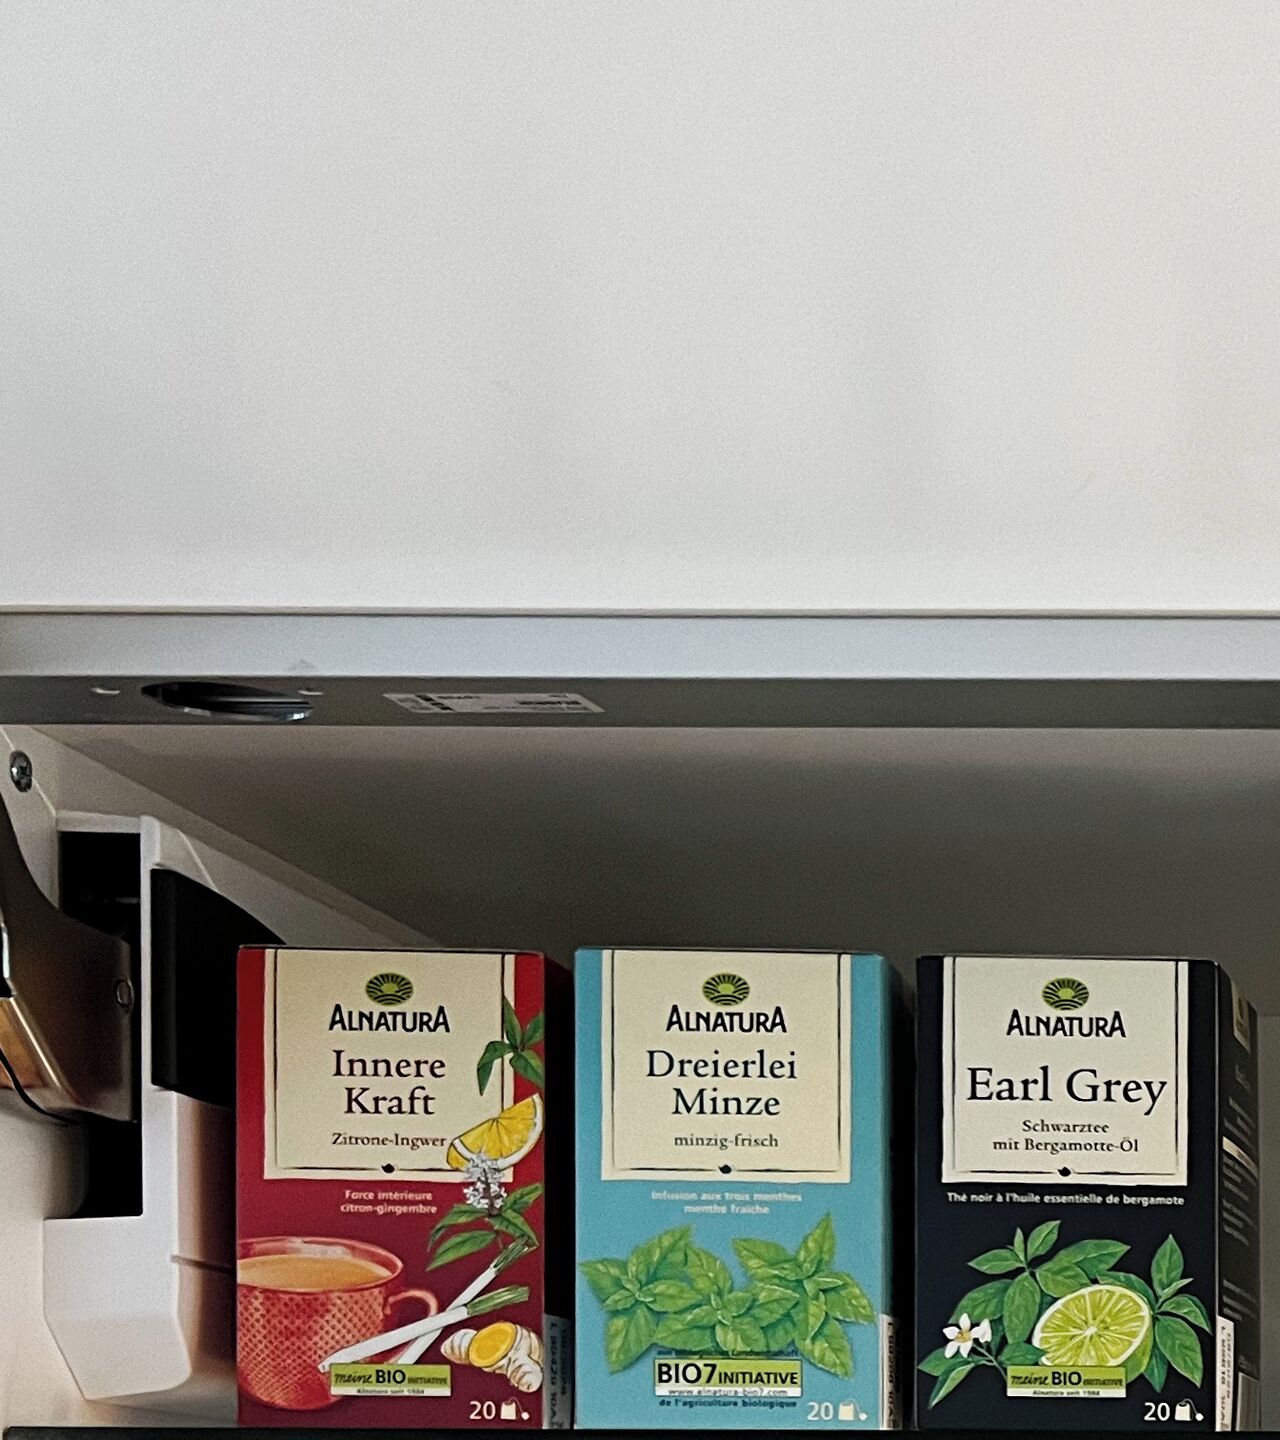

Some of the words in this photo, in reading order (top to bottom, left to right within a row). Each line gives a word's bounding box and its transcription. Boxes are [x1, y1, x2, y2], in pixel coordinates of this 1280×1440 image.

[329, 1004, 450, 1033] ALNATURA
[666, 1004, 787, 1033] ALNATURA
[1006, 1009, 1126, 1038] ALNATURA
[332, 1050, 446, 1078] Innere
[646, 1049, 797, 1079] Dreierlei
[966, 1065, 1053, 1101] Earl
[1066, 1068, 1167, 1116] Grey
[344, 1086, 436, 1115] Kraft
[672, 1087, 781, 1116] Minze
[1021, 1119, 1109, 1134] Schwarztee
[331, 1132, 447, 1151] Zitrone-Ingwer
[673, 1133, 779, 1151] minzig-frisch
[993, 1137, 1019, 1151] mit
[1024, 1136, 1139, 1155] Bergamotte-Öl
[970, 1192, 993, 1203] noir
[1043, 1193, 1103, 1204] essentielle
[1106, 1194, 1120, 1204] de
[1123, 1194, 1185, 1207] bergamote
[334, 1371, 373, 1385] meine
[375, 1369, 406, 1385] BIO
[1011, 1371, 1049, 1386] meine
[1051, 1371, 1082, 1386] BIO
[469, 1401, 496, 1420] 20
[807, 1402, 833, 1420] 20
[1144, 1402, 1170, 1421] 20
